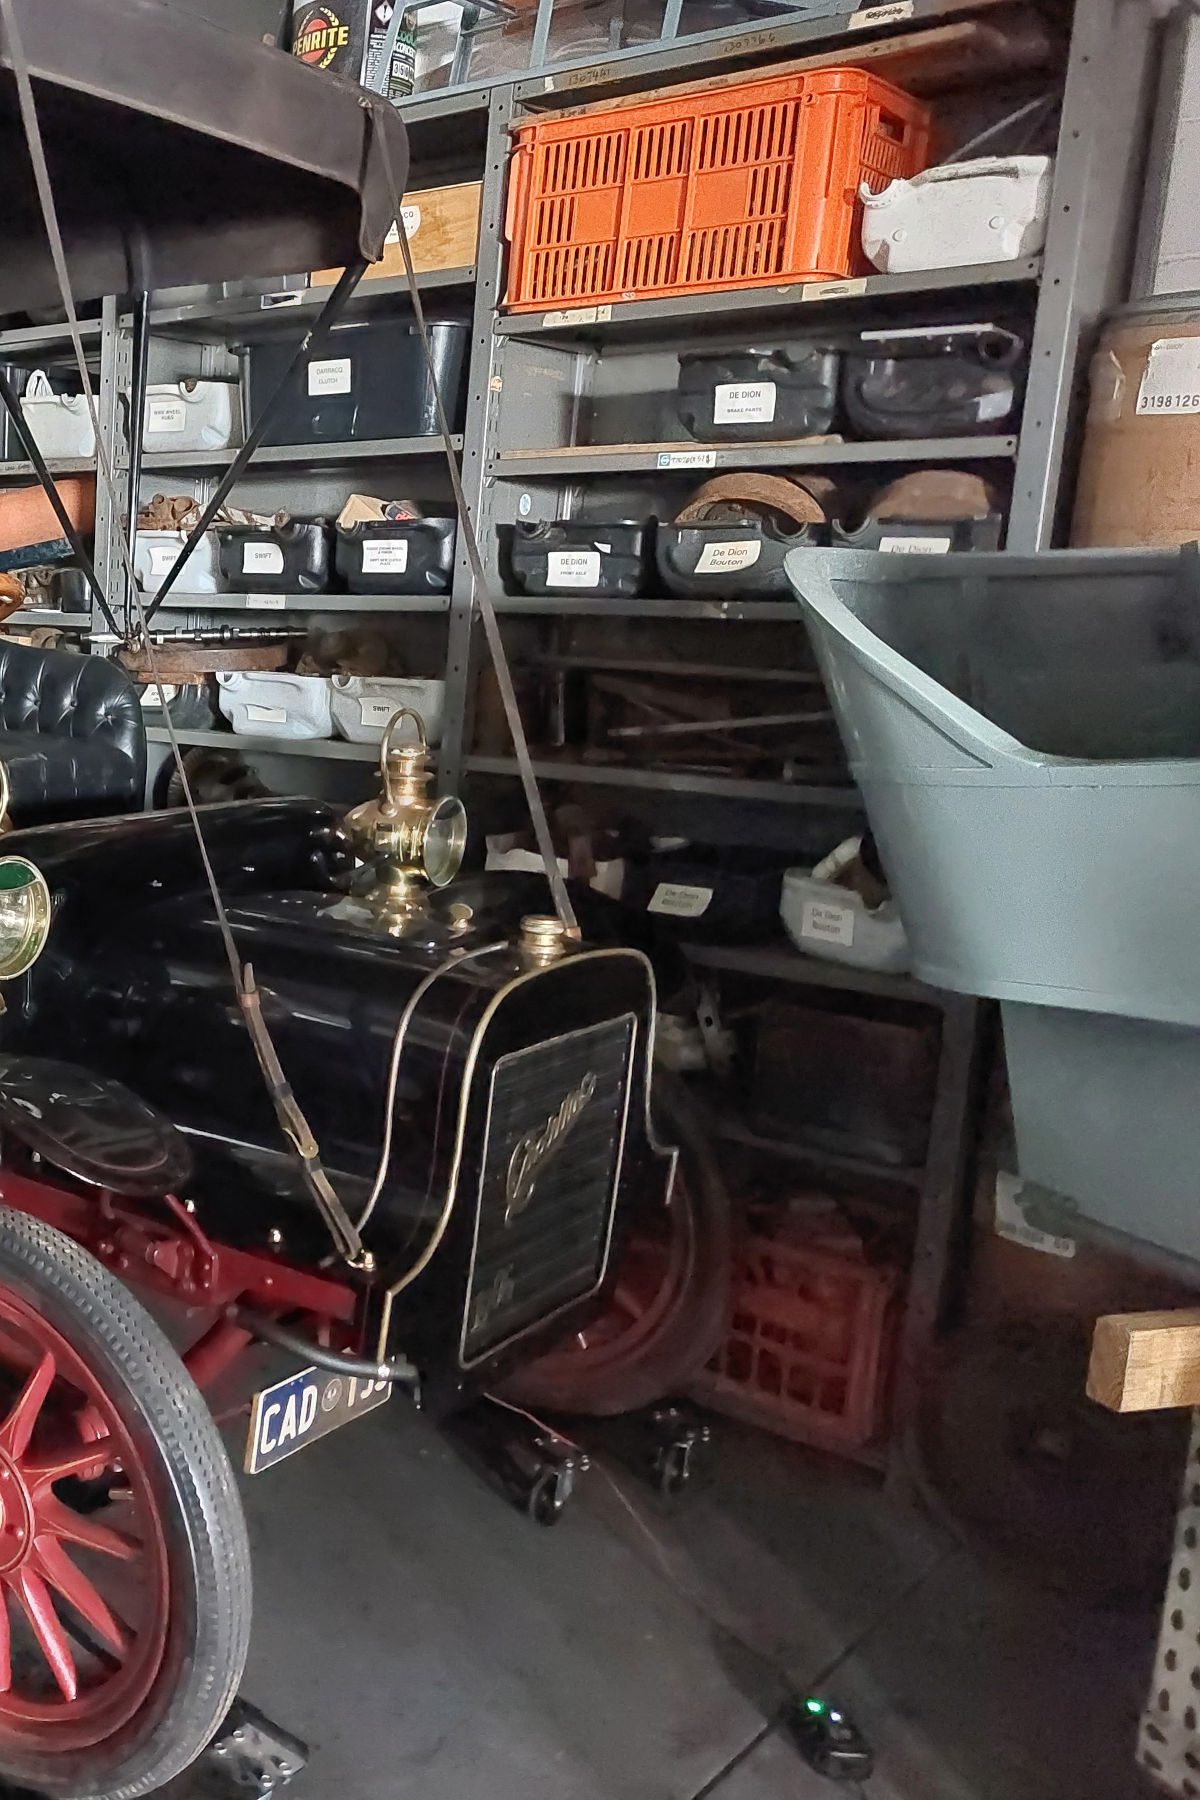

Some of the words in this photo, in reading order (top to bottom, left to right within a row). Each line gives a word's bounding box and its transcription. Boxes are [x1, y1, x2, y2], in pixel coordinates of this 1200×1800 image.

[292, 26, 349, 56] PENRITE
[316, 367, 343, 375] DARRACQ
[729, 391, 740, 399] DE
[1141, 395, 1200, 408] 3198126
[712, 549, 725, 557] De
[728, 548, 748, 556] Dion
[260, 1384, 318, 1455] CAD
